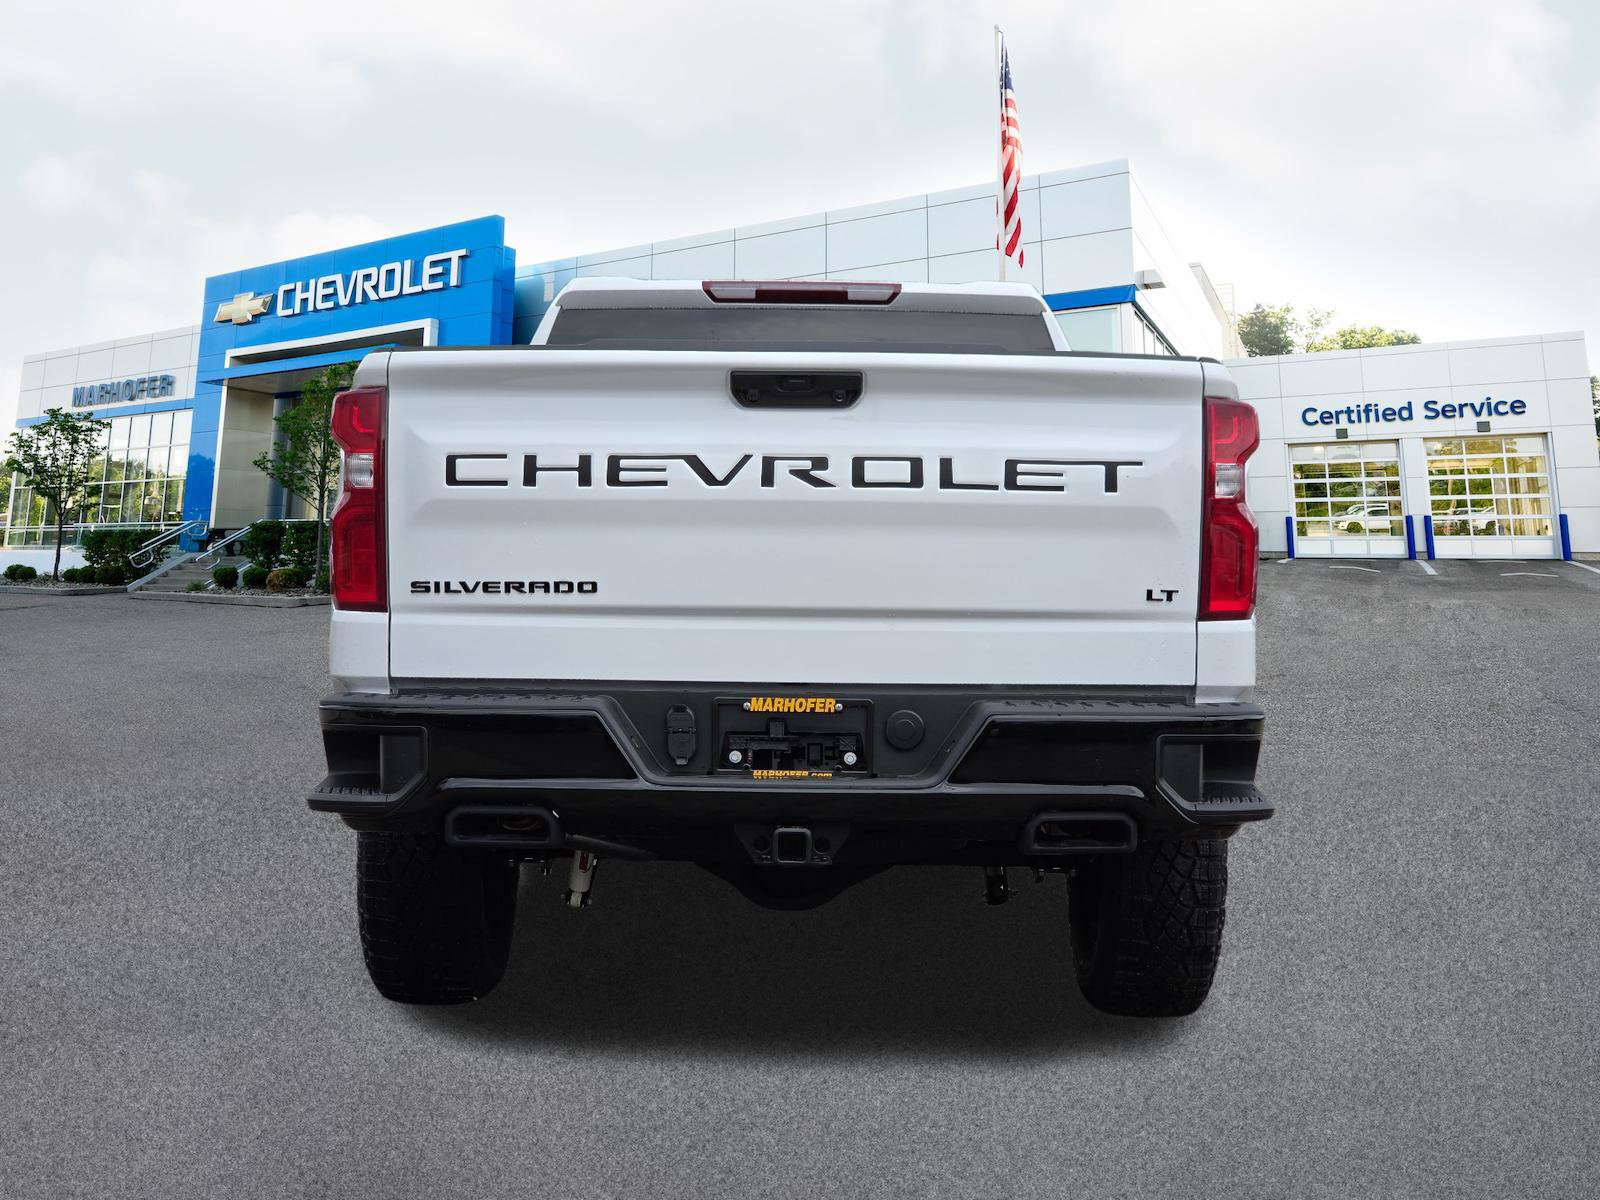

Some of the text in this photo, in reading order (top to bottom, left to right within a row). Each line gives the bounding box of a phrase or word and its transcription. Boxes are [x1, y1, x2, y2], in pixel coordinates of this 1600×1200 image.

[276, 249, 471, 317] CHEVROLET
[72, 375, 175, 407] MARHOFER
[1301, 397, 1527, 426] Certified Service
[445, 453, 1143, 493] CHEVROLET
[410, 580, 598, 595] SILVERADO
[1146, 588, 1179, 603] LT
[750, 697, 835, 713] MARHOFER
